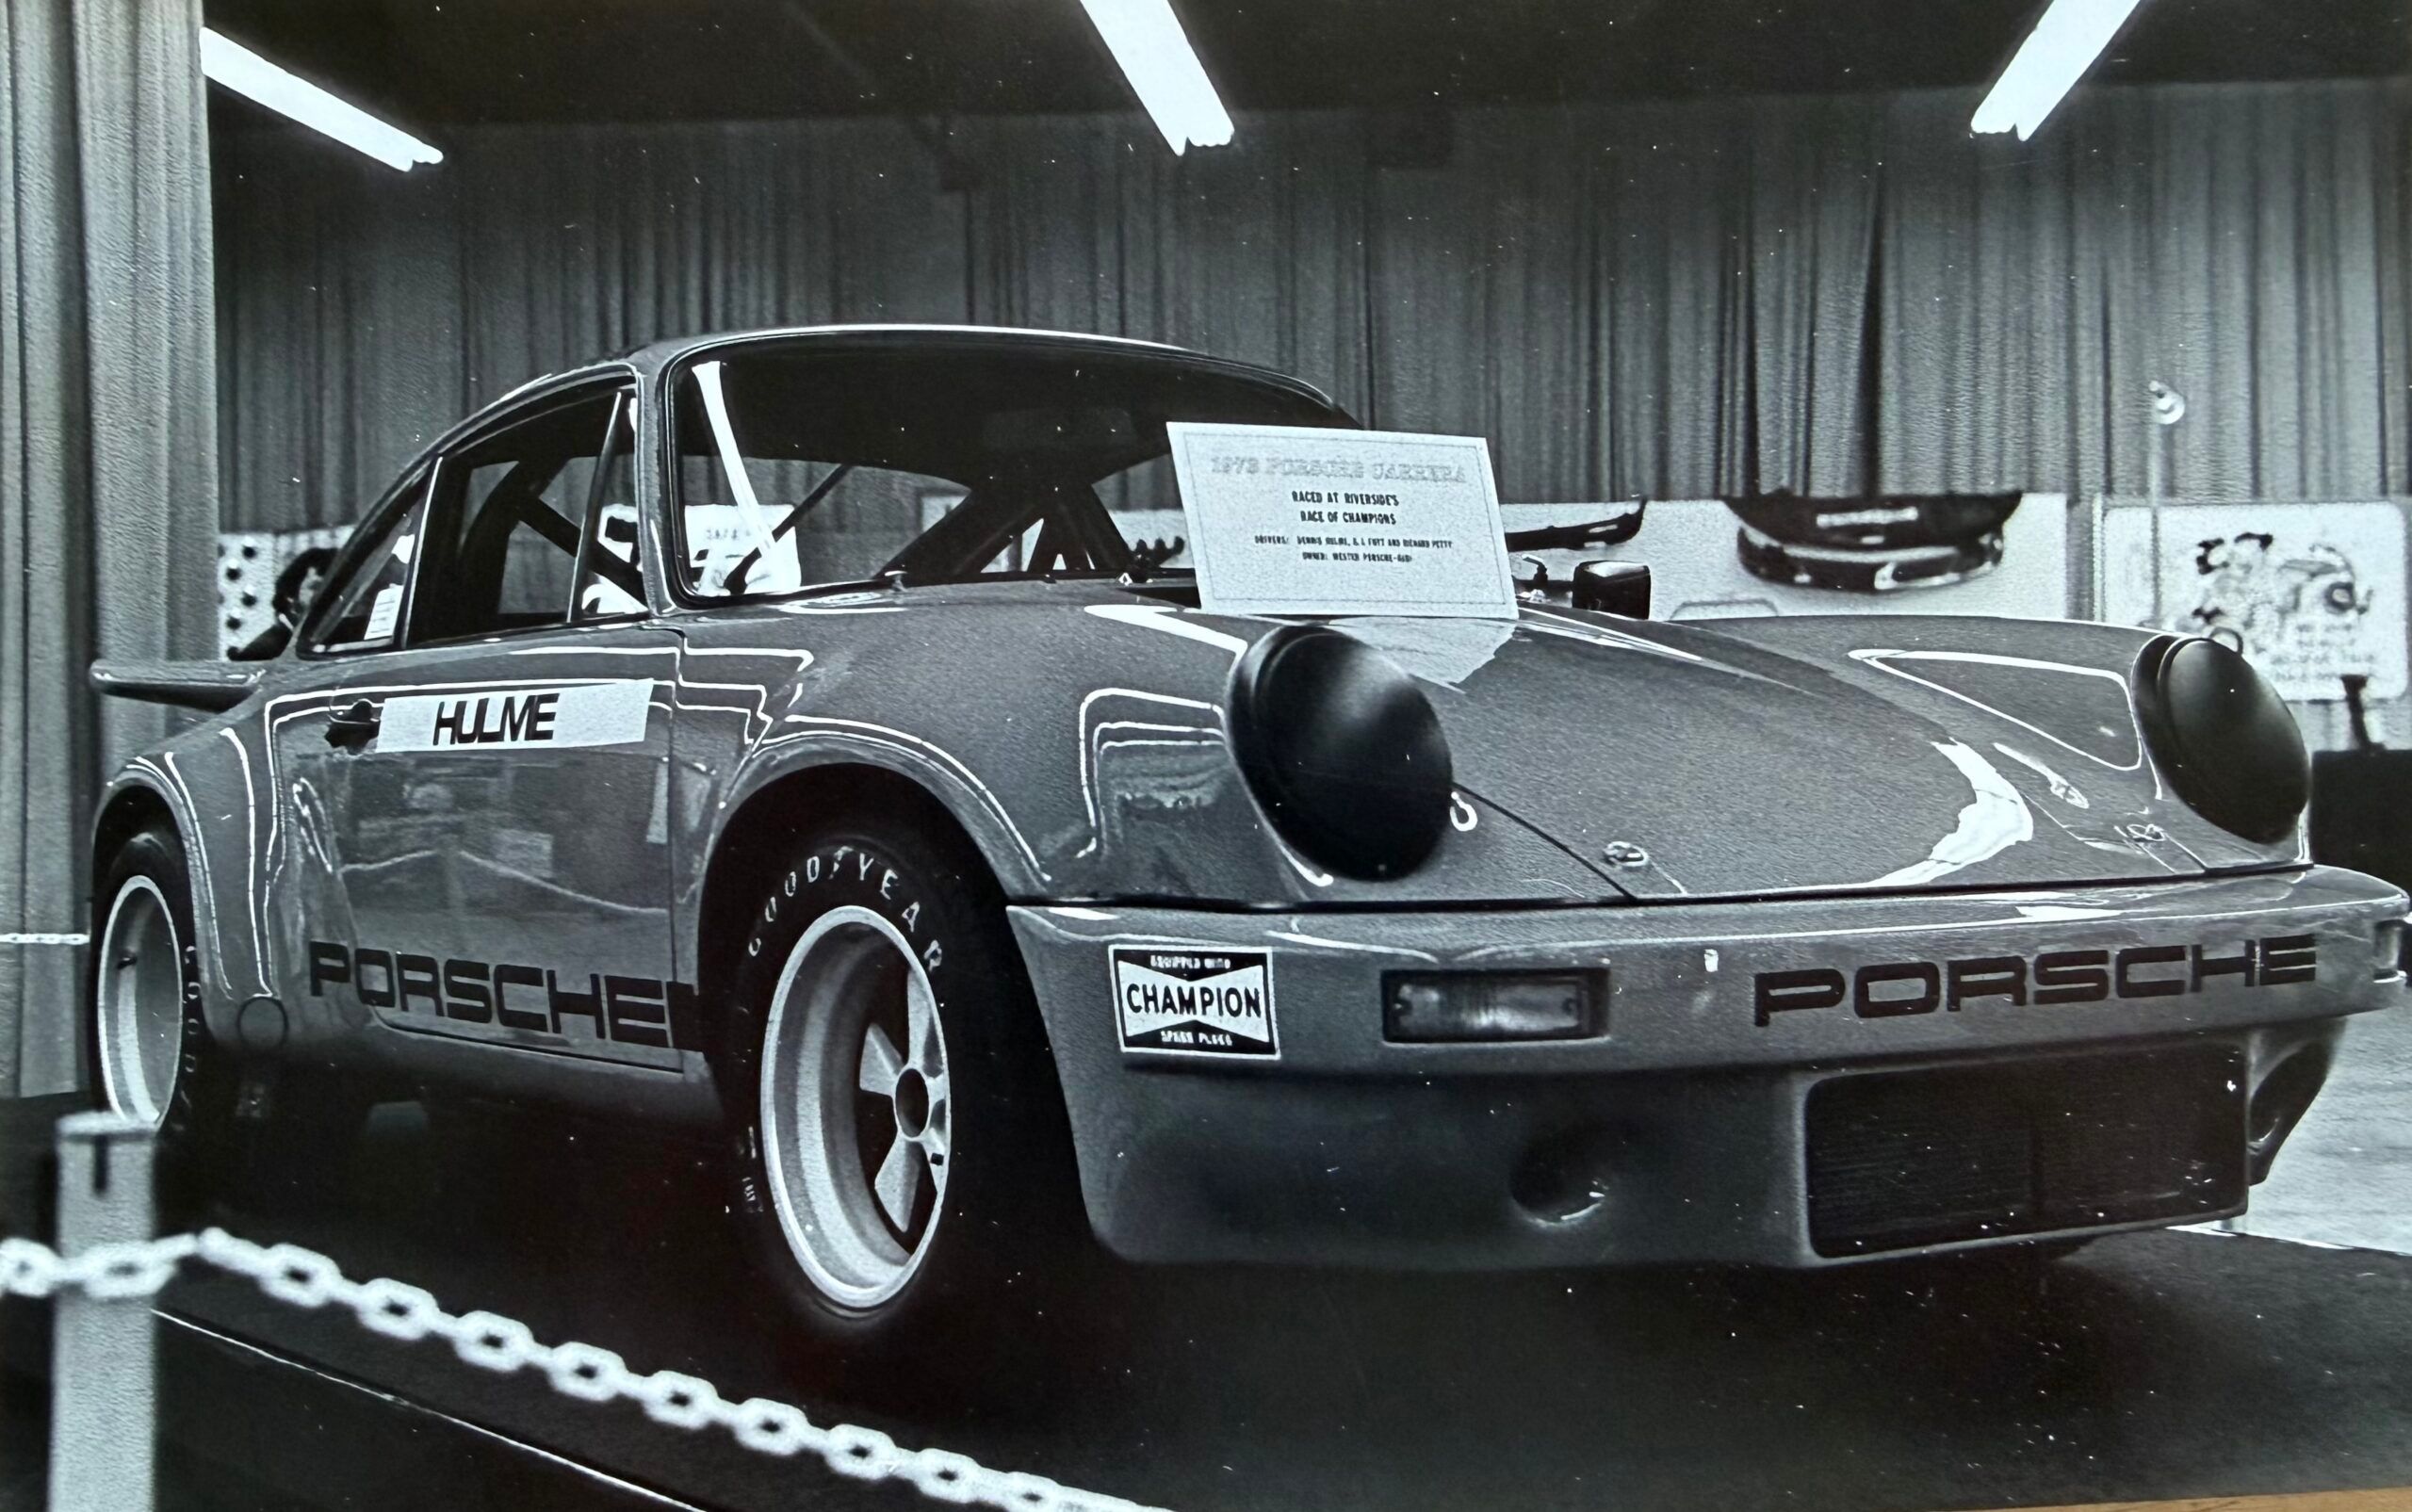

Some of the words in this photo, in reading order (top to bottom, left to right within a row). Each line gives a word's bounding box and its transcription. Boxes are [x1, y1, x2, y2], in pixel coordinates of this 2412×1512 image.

[1292, 491, 1323, 503] RACED
[1328, 492, 1339, 503] AT
[1300, 511, 1325, 523] RACE
[1328, 512, 1338, 523] OF
[1343, 512, 1396, 525] CHAMPIONS
[1431, 540, 1452, 548] PETTY
[432, 692, 560, 745] HULME
[747, 845, 943, 972] GOODYEAR
[309, 940, 670, 1048] PORSCHE
[1126, 983, 1263, 1018] CHAMPION
[1754, 934, 2317, 1027] PORSCHE
